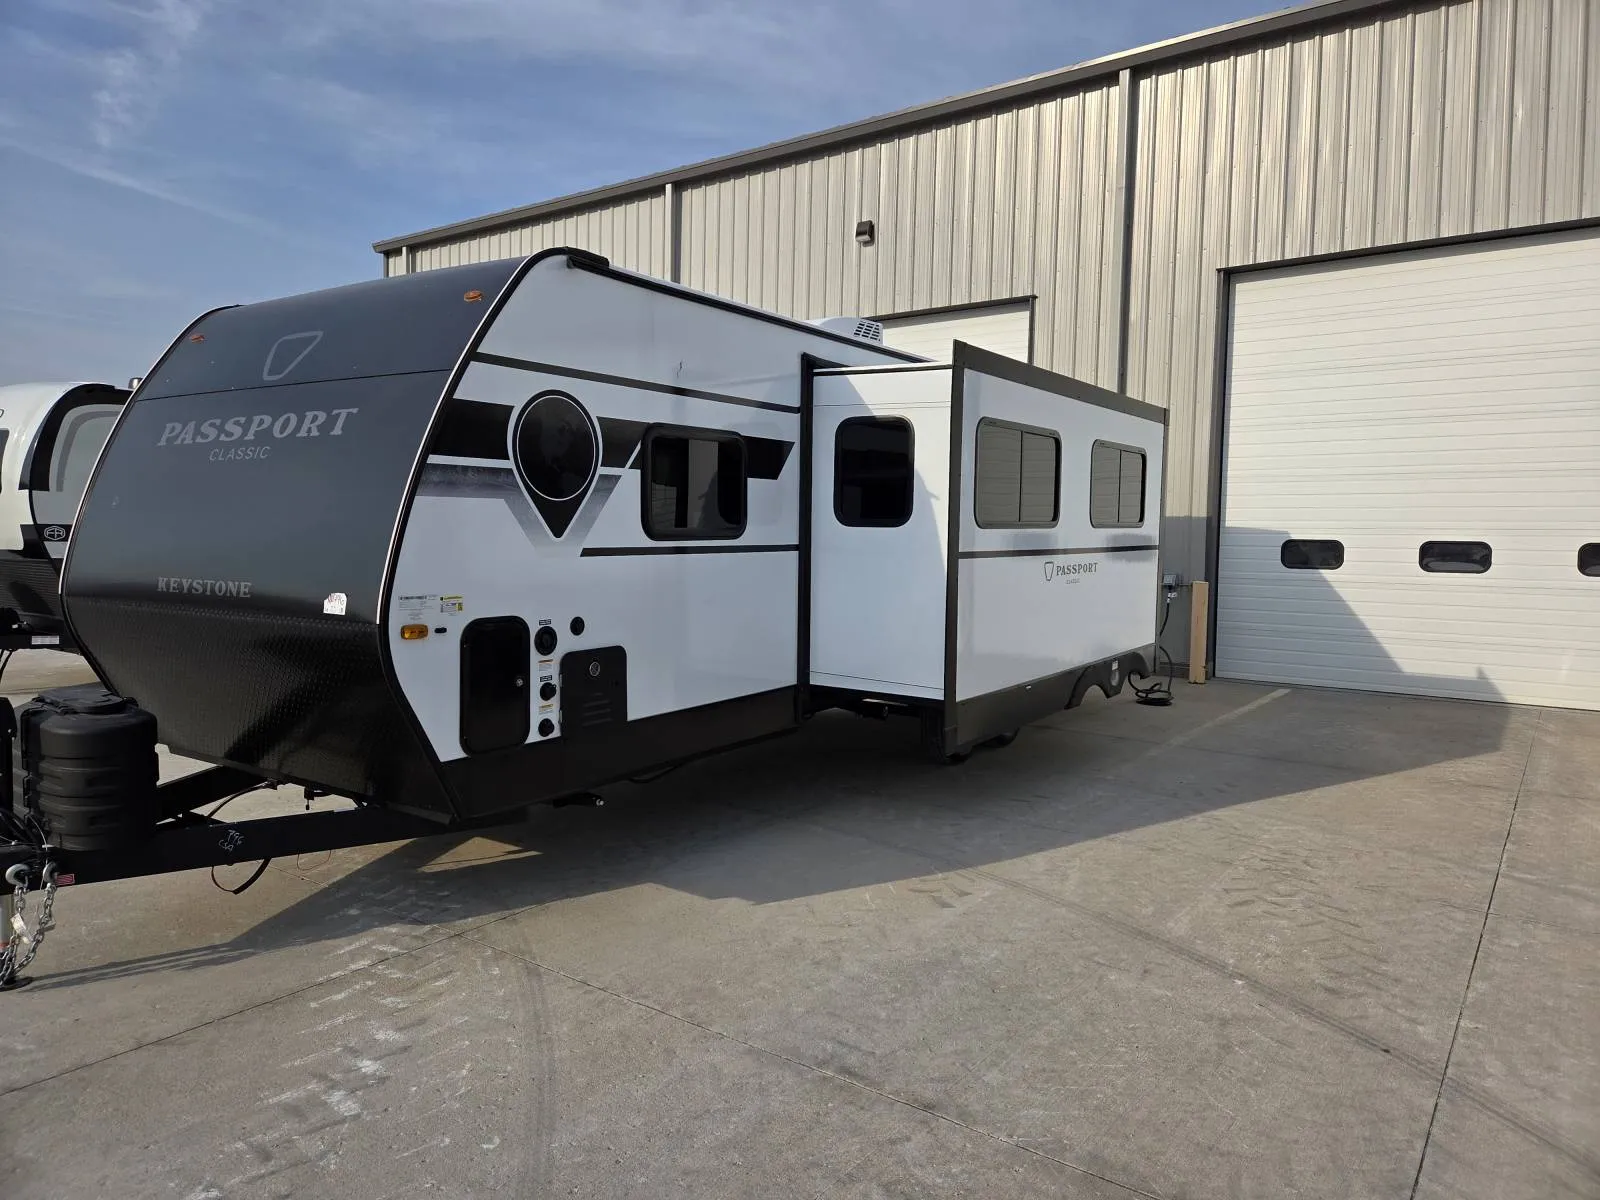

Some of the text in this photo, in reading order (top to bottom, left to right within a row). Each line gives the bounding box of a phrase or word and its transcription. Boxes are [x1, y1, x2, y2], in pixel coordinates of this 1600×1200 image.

[156, 407, 360, 446] PASSPORT
[208, 446, 271, 462] CLASSIC
[1055, 562, 1099, 577] PASSPORT
[156, 576, 253, 598] KEYSTONE
